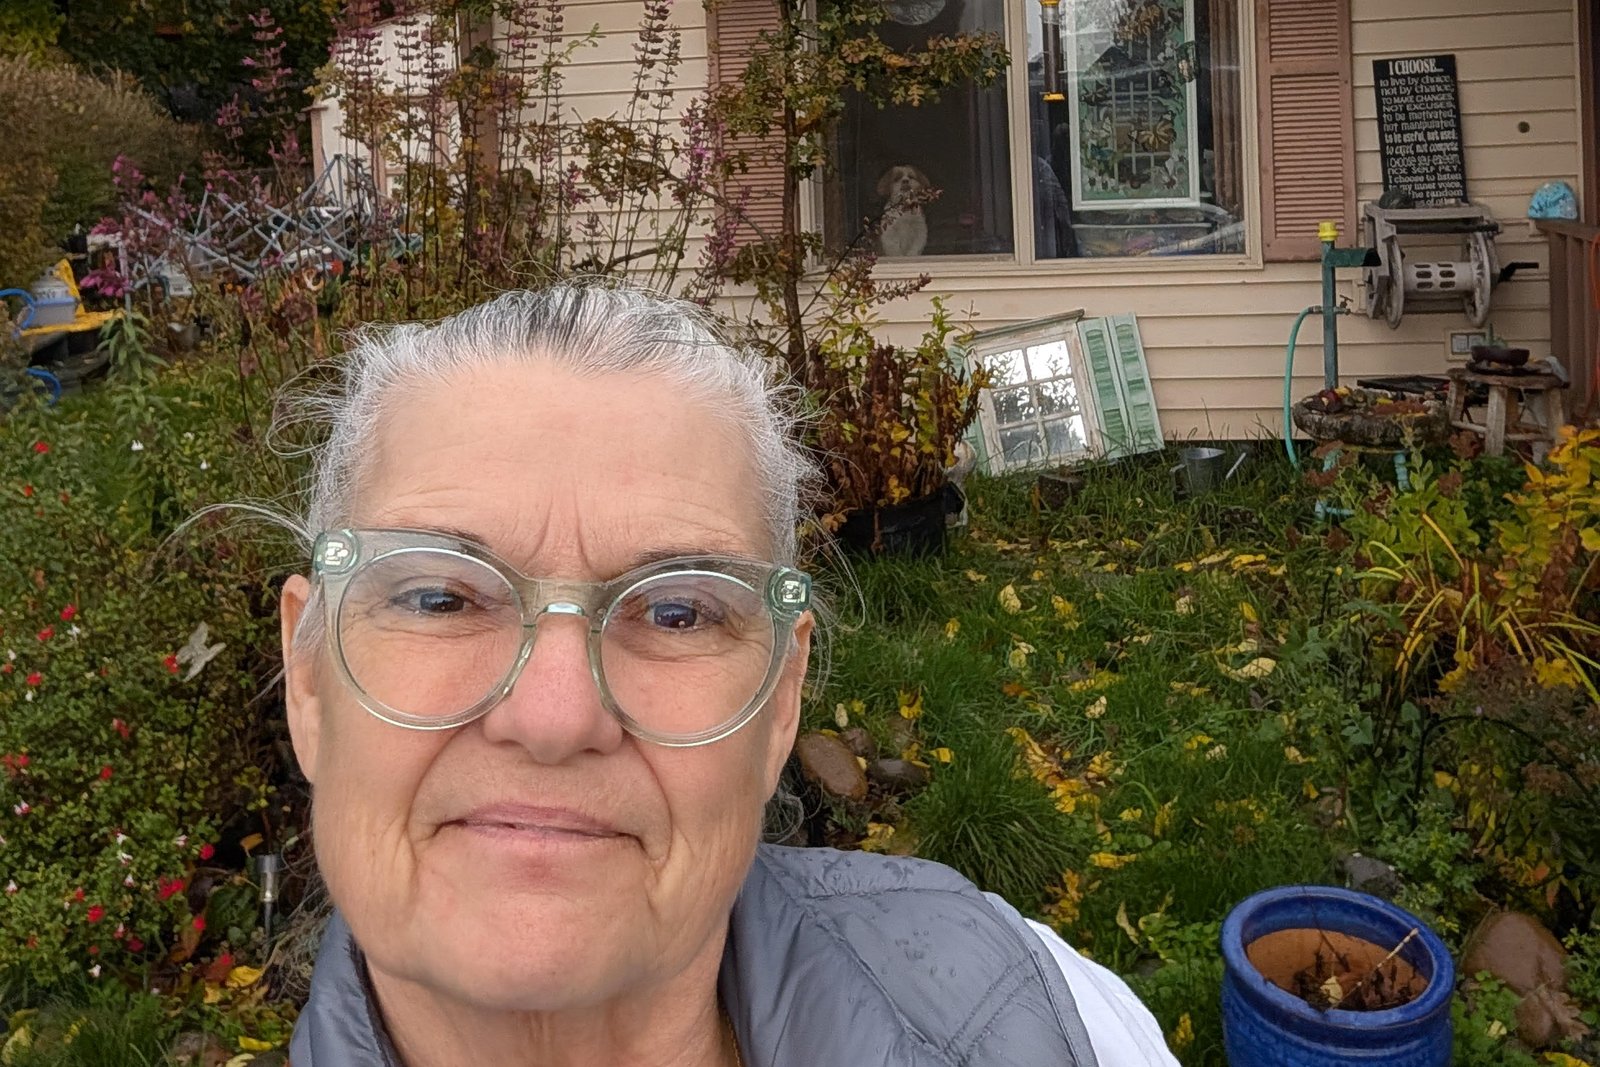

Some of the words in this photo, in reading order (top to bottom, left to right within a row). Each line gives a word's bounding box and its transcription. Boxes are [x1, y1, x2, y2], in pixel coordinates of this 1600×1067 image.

[1389, 61, 1394, 75] I
[1380, 79, 1389, 87] to
[1390, 77, 1406, 86] live
[1408, 76, 1420, 86] by
[1381, 87, 1397, 96] not
[1400, 86, 1412, 95] by
[1393, 95, 1414, 103] MAKE
[1383, 104, 1403, 112] NOT
[1383, 113, 1392, 123] to
[1395, 112, 1405, 120] be
[1384, 122, 1398, 132] not
[1385, 133, 1393, 143] to
[1427, 130, 1439, 141] not
[1386, 145, 1394, 155] to
[1394, 174, 1424, 184] choose
[1426, 174, 1435, 182] to
[1414, 182, 1435, 190] inner
[1426, 189, 1463, 199] random
